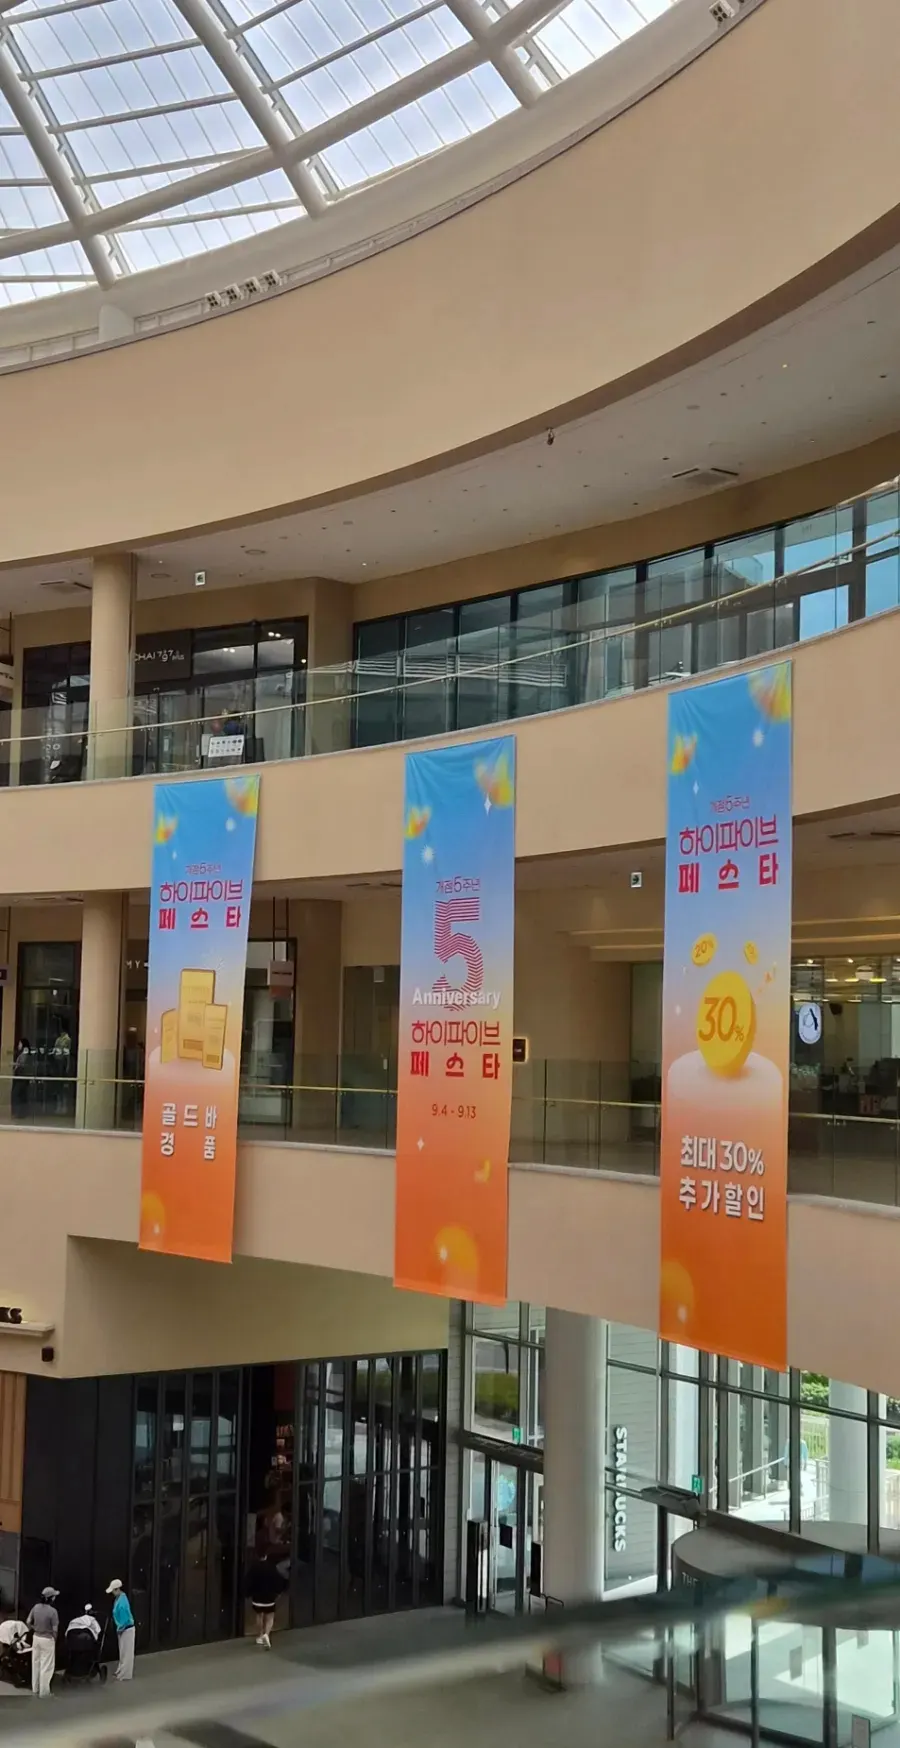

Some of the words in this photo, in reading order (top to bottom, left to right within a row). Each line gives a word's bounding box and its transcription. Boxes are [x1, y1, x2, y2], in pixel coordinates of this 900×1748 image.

[679, 814, 779, 856] 하이파이브
[160, 879, 243, 903] 하이파이브
[411, 987, 501, 1010] Anniversary
[411, 1020, 501, 1047] 하이파이브
[698, 995, 745, 1043] 30%
[680, 1135, 716, 1170] 최대
[720, 1140, 765, 1176] 30%
